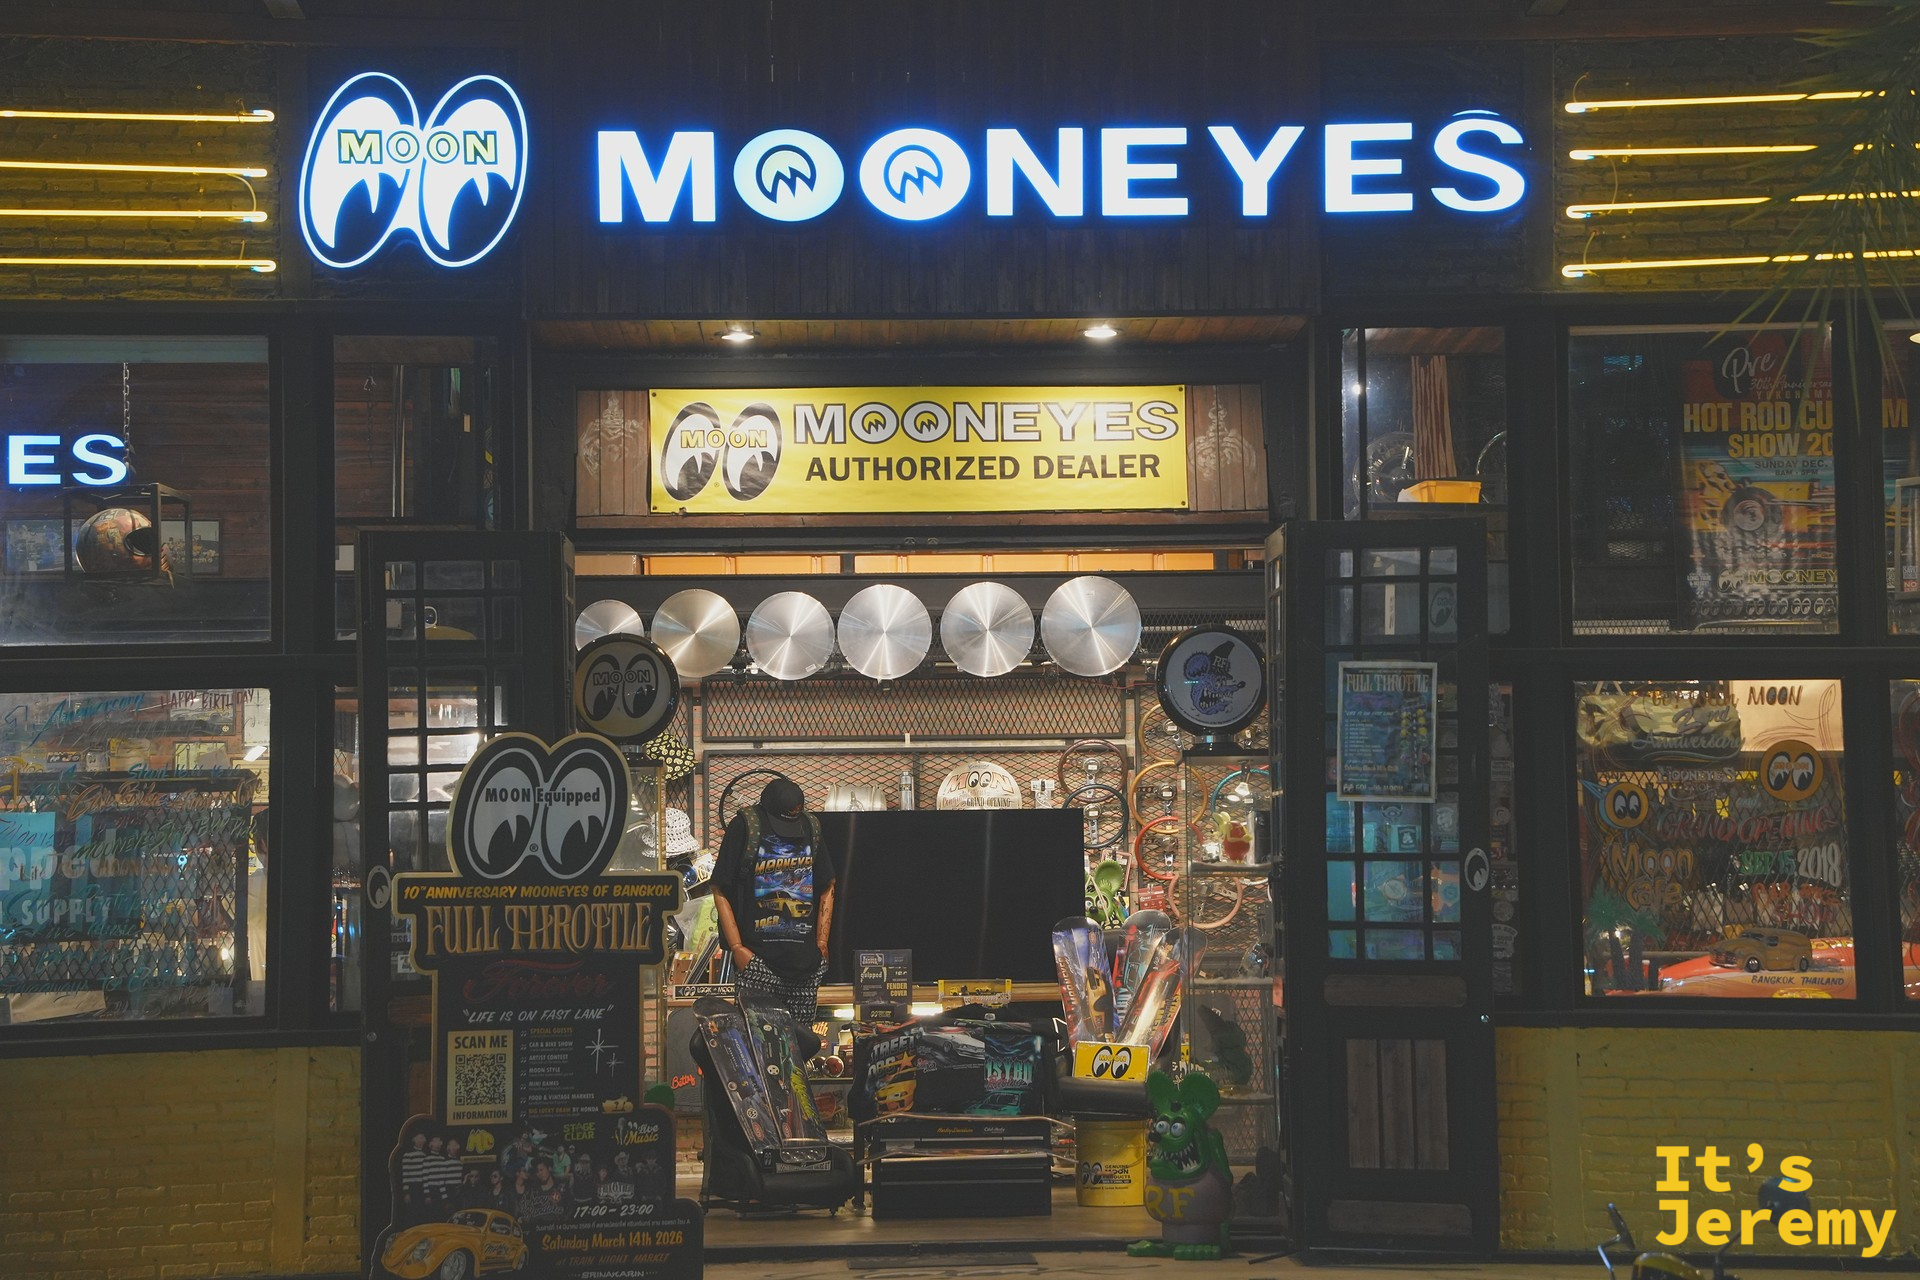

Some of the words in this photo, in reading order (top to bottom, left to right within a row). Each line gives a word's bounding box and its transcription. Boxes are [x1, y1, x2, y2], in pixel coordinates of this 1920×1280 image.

[337, 125, 499, 166] MOON
[598, 117, 1526, 223] MOONEYES
[1721, 347, 1776, 394] Pre
[793, 400, 1180, 445] MOONEYES
[1683, 402, 1733, 433] HOT
[1740, 401, 1792, 432] ROD
[680, 428, 768, 449] MOON
[1728, 433, 1800, 459] SHOW
[805, 455, 1021, 482] AUTHORIZED
[1033, 453, 1161, 480] DEALER
[1754, 460, 1798, 470] SUNDAY
[1802, 459, 1829, 469] DEC.
[592, 669, 651, 686] MOON
[1345, 673, 1374, 693] FULL
[160, 692, 198, 710] HAPPY
[1747, 685, 1802, 706] MOON
[1631, 732, 1746, 756] Anniversary
[485, 788, 531, 803] MOON
[535, 787, 600, 807] Equipped
[1657, 810, 1738, 842] GRAND
[1608, 843, 1694, 882] Moon
[1797, 842, 1843, 888] 2018
[426, 885, 517, 900] ANNIVERSARY
[520, 885, 588, 898] MOONEYES
[593, 885, 608, 897] OF
[613, 884, 673, 897] BANGKOK
[424, 905, 501, 956] FULL
[504, 902, 652, 954] THROTTLE
[886, 982, 908, 990] FENDER
[1751, 975, 1795, 986] BANGKOK
[1801, 975, 1844, 986] THAILAND
[463, 1009, 496, 1023] "LIFE
[500, 1009, 514, 1022] IS
[518, 1009, 538, 1021] ON
[540, 1008, 571, 1020] FAST
[574, 1004, 614, 1020] LANE"
[455, 1035, 487, 1049] SCAN
[489, 1035, 508, 1048] ME
[453, 1109, 508, 1120] INFORMATION
[563, 1122, 596, 1132] STAGE
[564, 1131, 596, 1142] CLEAR
[627, 1132, 659, 1146] Music
[574, 1204, 607, 1218] 17:00
[620, 1204, 654, 1216] 23:00
[1144, 1185, 1197, 1219] RF
[542, 1233, 590, 1252] Saturday
[591, 1232, 625, 1248] March
[628, 1231, 651, 1247] 14th
[655, 1230, 683, 1246] 2026
[569, 1256, 595, 1265] TRAIN
